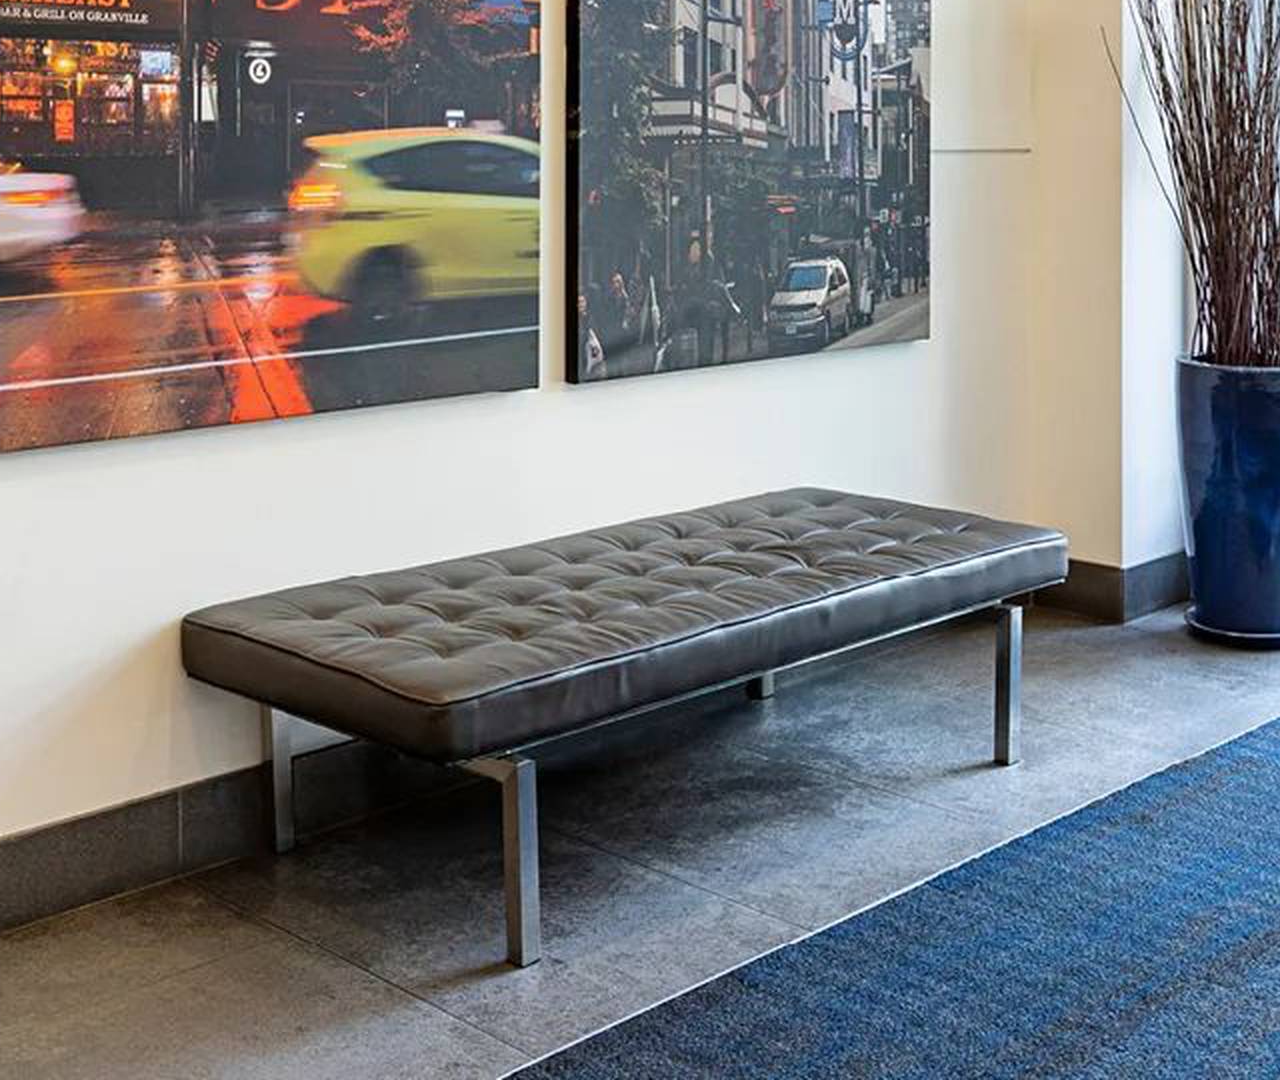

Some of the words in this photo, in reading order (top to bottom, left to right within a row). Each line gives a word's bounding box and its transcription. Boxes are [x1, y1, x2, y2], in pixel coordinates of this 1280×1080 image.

[23, 9, 32, 19] &
[34, 9, 66, 20] GRILL
[86, 11, 149, 25] GRANVILLE
